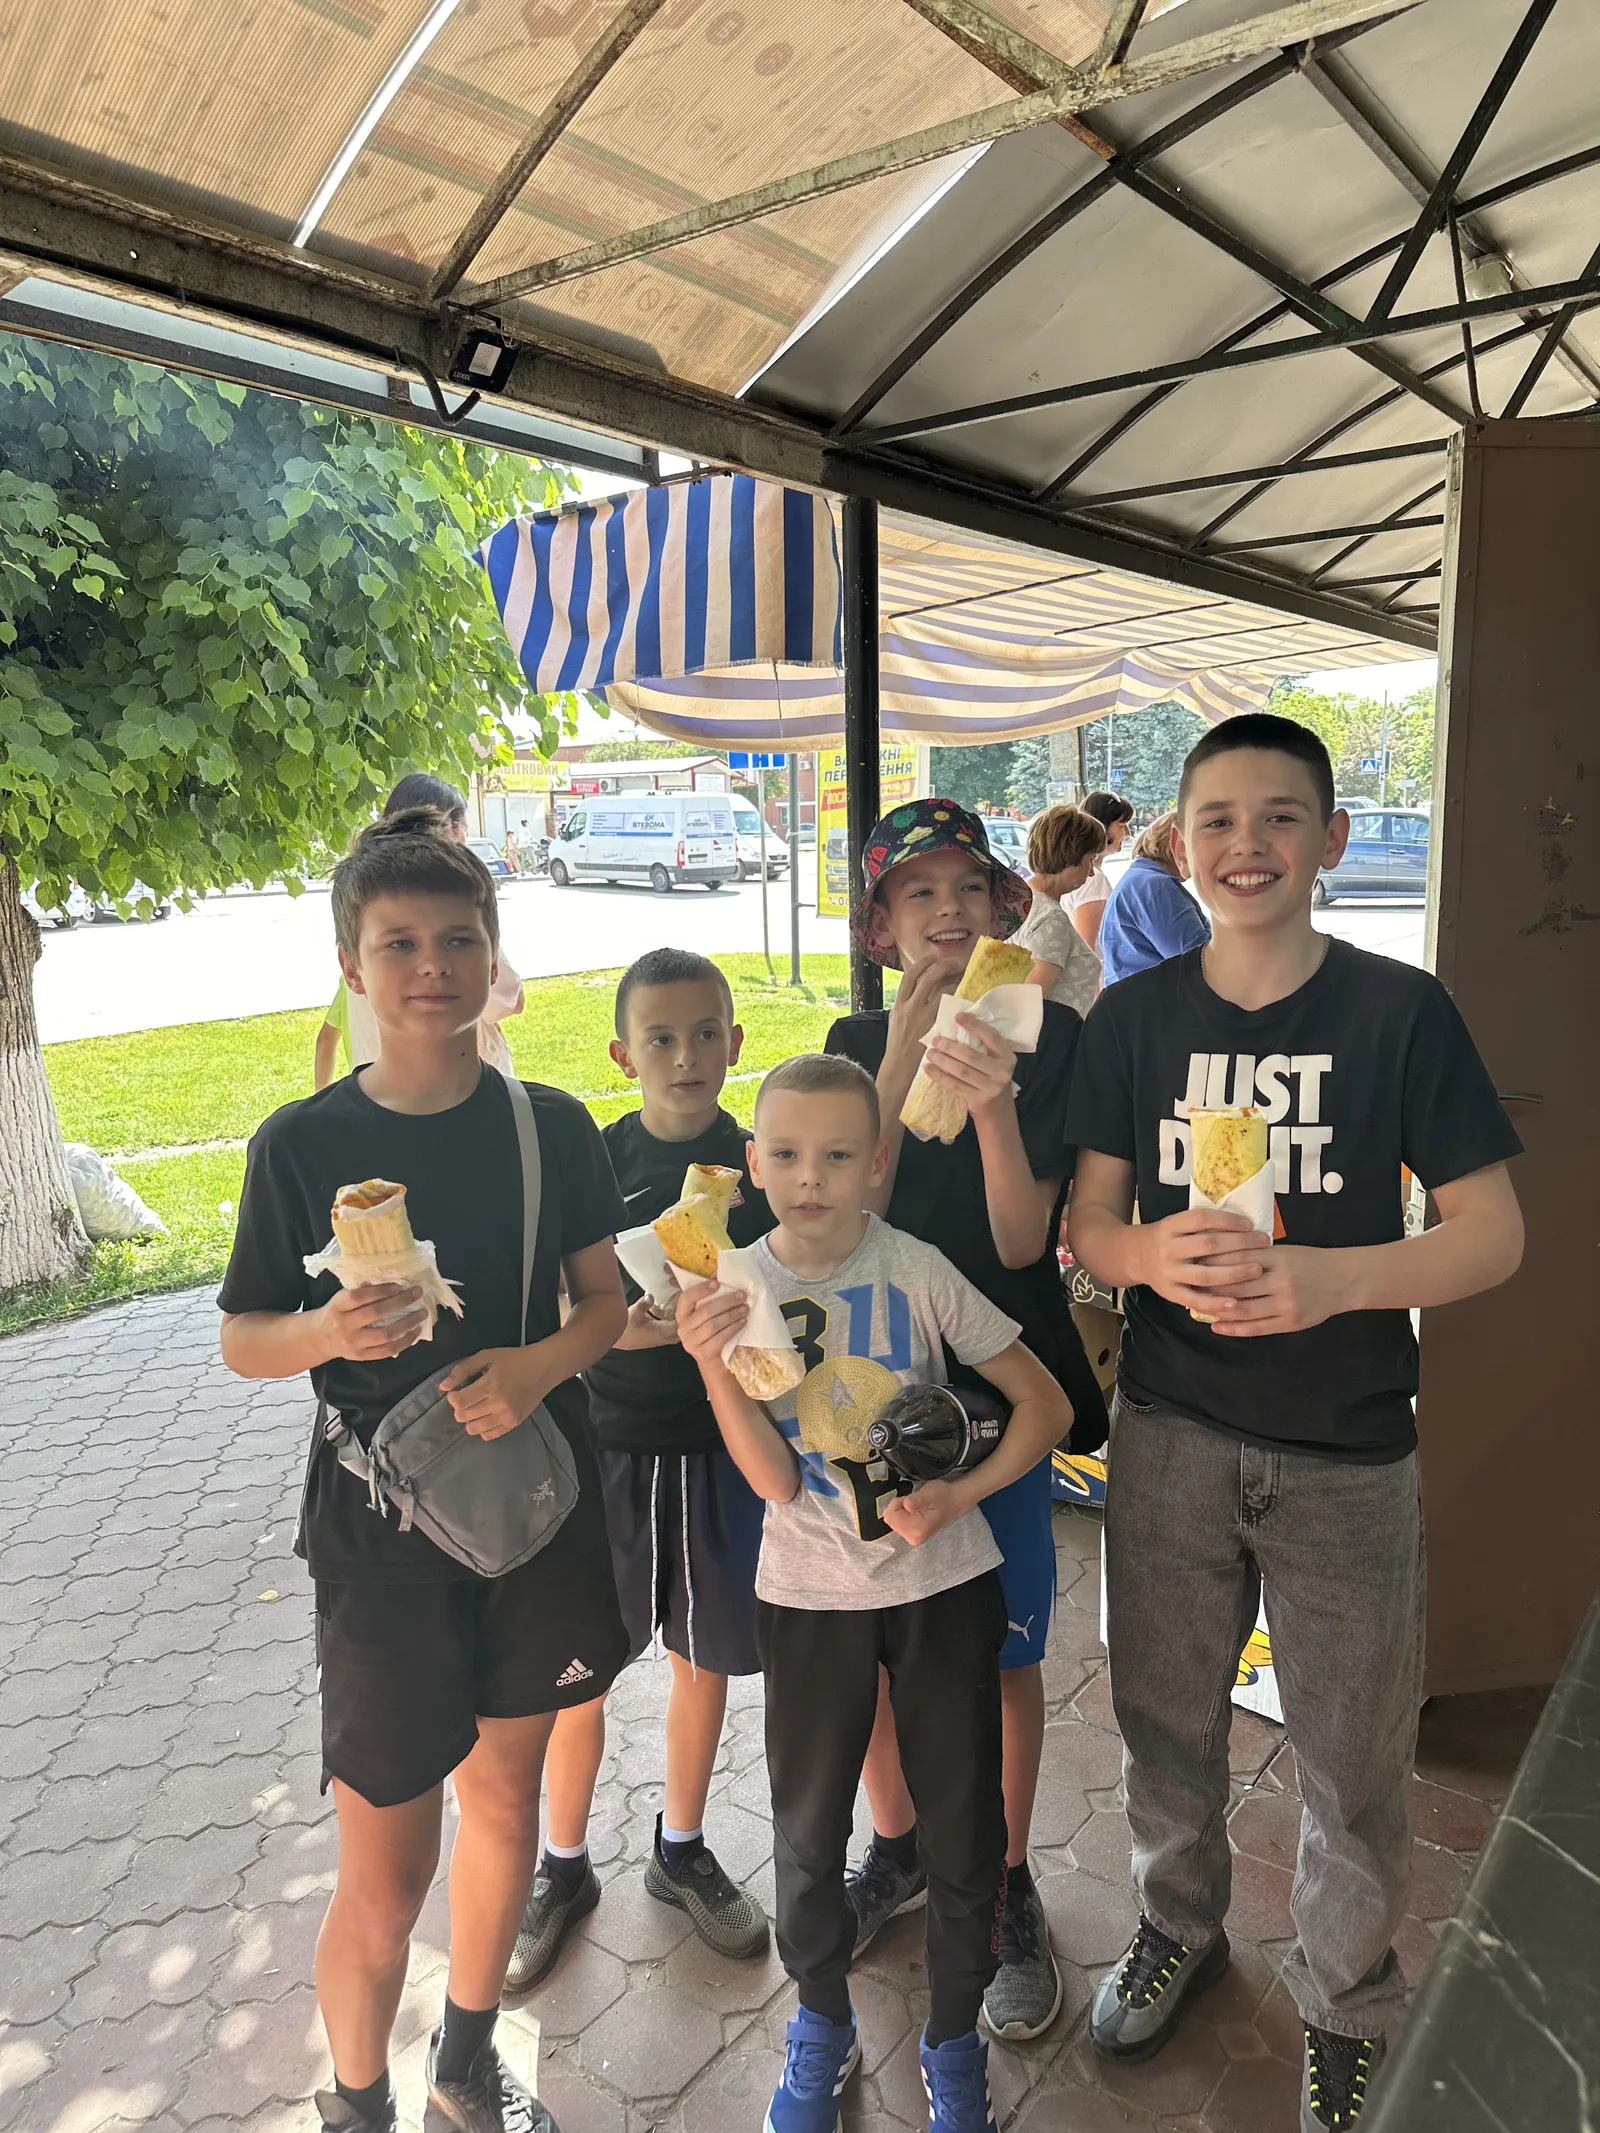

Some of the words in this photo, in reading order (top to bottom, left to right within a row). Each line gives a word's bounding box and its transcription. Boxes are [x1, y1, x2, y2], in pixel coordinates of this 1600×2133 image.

[1173, 1053, 1333, 1124] JUST
[1269, 1126, 1344, 1195] IT.
[556, 1669, 594, 1687] adidas
